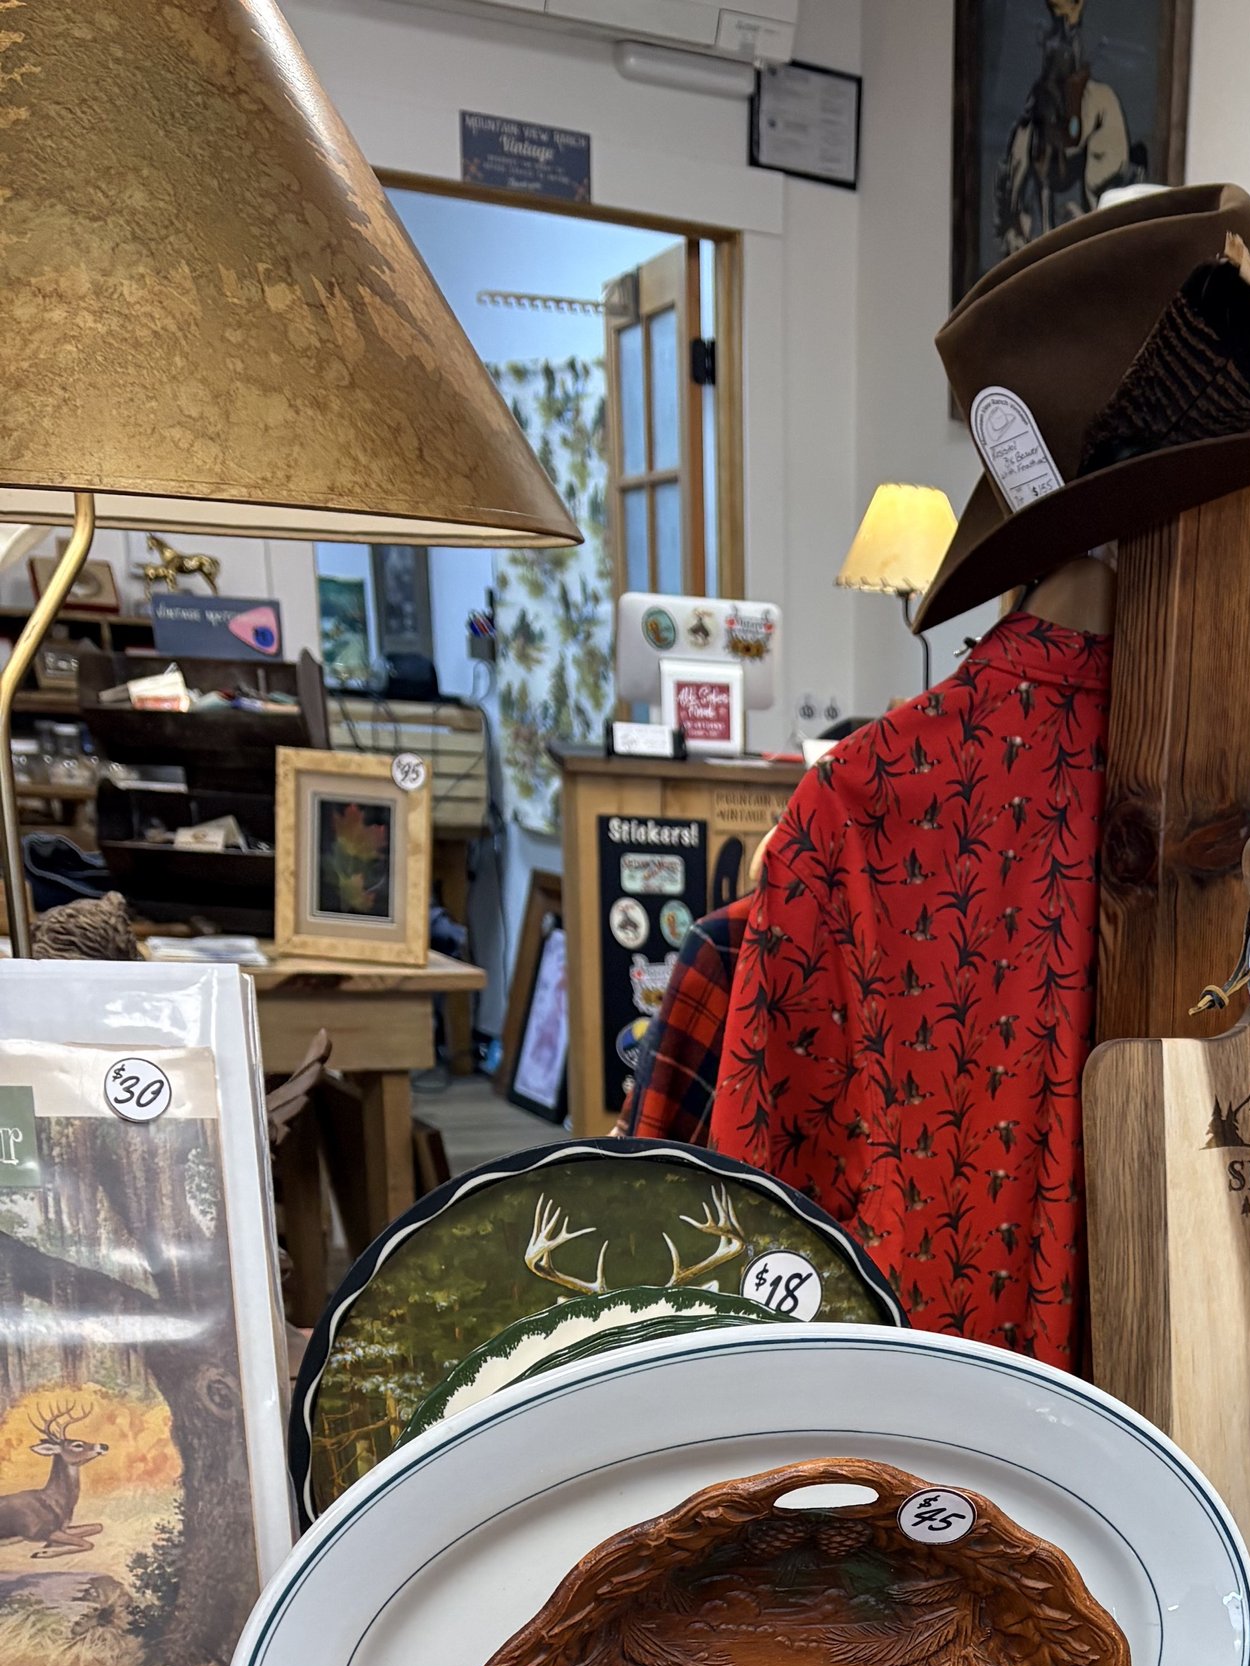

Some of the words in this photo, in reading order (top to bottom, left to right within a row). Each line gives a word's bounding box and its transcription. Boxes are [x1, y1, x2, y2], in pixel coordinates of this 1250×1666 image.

[499, 135, 554, 162] Vintage
[607, 816, 700, 847] Stickers!
[112, 1063, 164, 1108] $30
[755, 1262, 813, 1315] $18
[911, 1494, 966, 1531] $45
